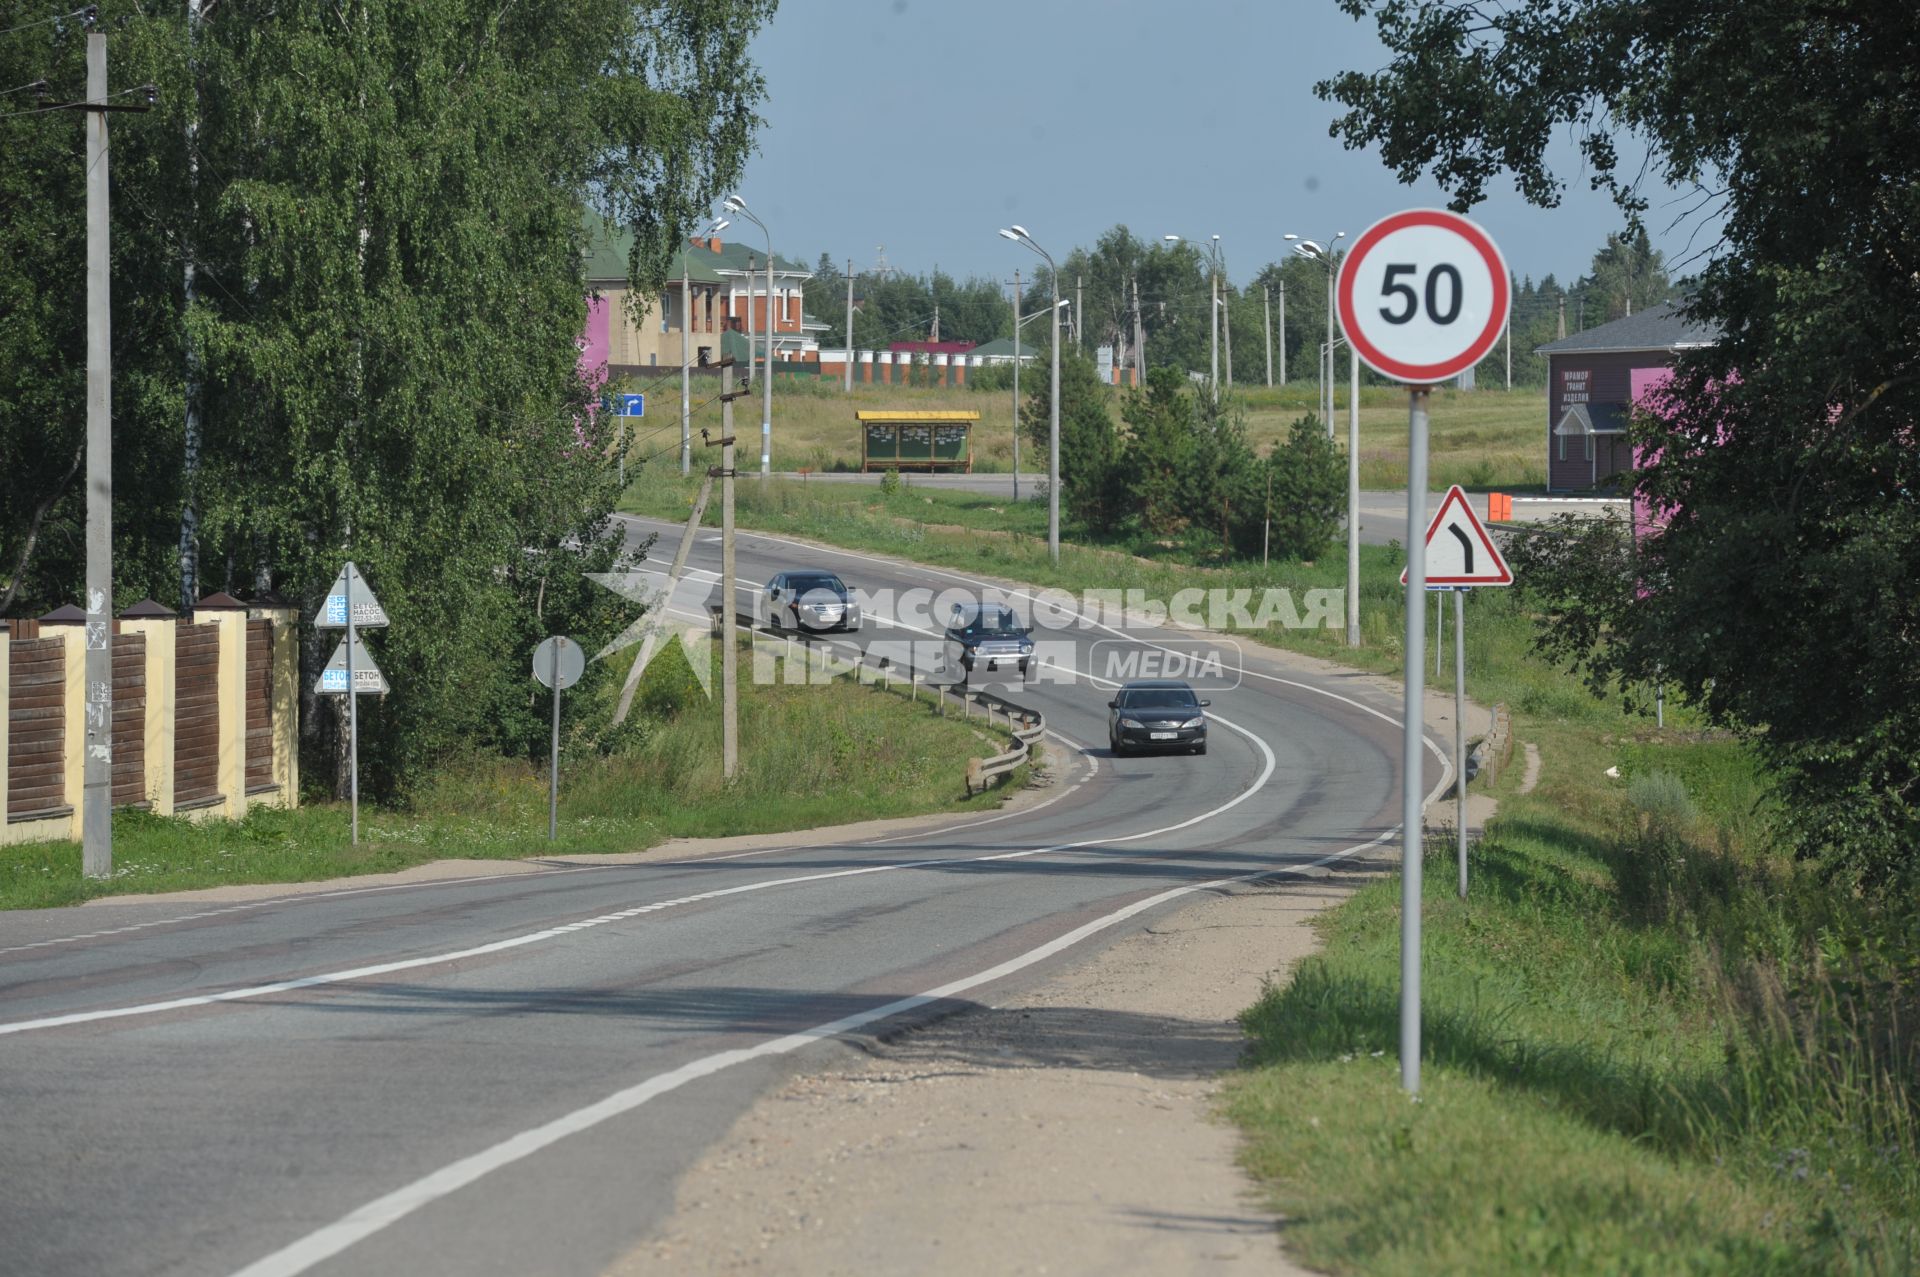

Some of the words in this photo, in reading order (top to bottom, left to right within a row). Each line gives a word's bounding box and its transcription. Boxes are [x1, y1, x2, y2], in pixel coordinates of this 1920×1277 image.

[1379, 263, 1462, 325] 50
[1564, 371, 1588, 380] МРАМОР
[1567, 381, 1586, 391] ГРАНИТ
[1563, 393, 1589, 402] ИЗДЕЛИЯ
[337, 596, 349, 623] БЕТОН
[324, 671, 350, 680] БЕТОН
[355, 671, 380, 680] БЕТОН
